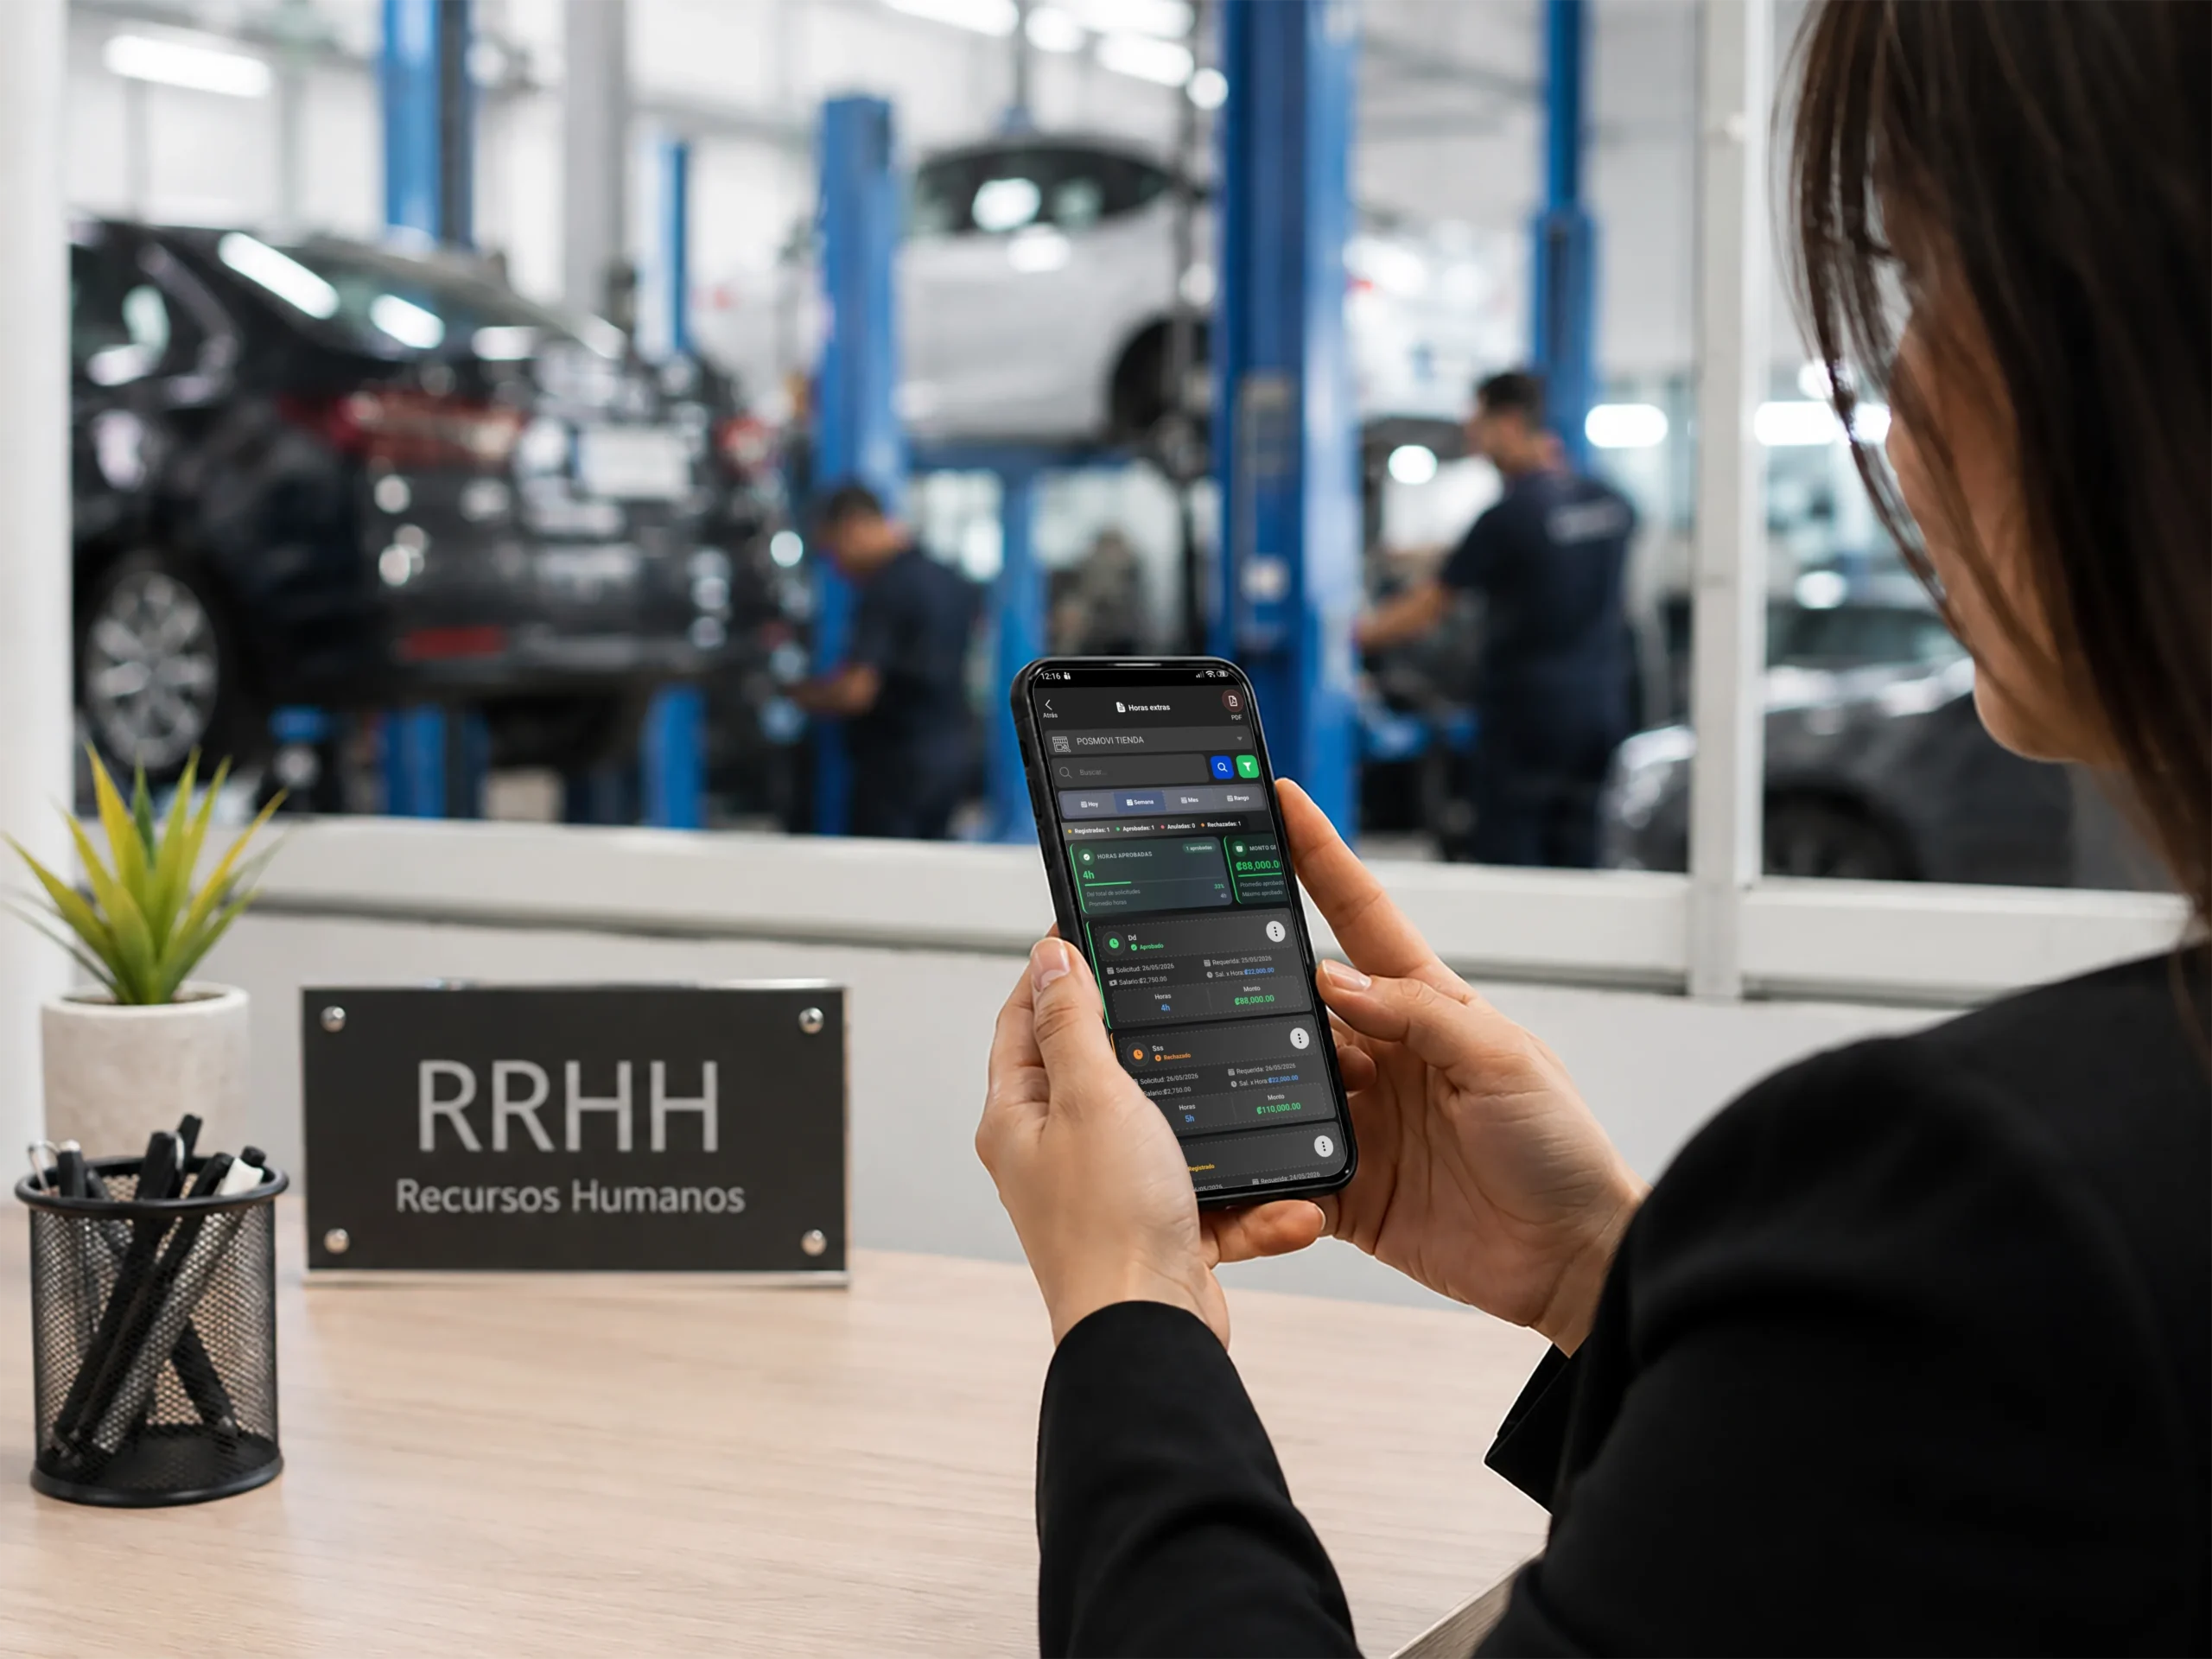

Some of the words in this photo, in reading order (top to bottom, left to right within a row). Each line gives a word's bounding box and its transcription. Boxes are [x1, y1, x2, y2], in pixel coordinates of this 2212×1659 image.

[1236, 860, 1281, 871] ₡88,000.0
[1083, 870, 1095, 879] 4h
[1236, 1066, 1264, 1075] Requerida:
[1265, 1063, 1296, 1071] 26/05/2026
[1166, 1073, 1198, 1082] 26/05/2026
[418, 1060, 718, 1153] RRHH
[1188, 1163, 1215, 1172] Registrado
[397, 1179, 560, 1213] Recursos
[572, 1179, 746, 1213] Humanos
